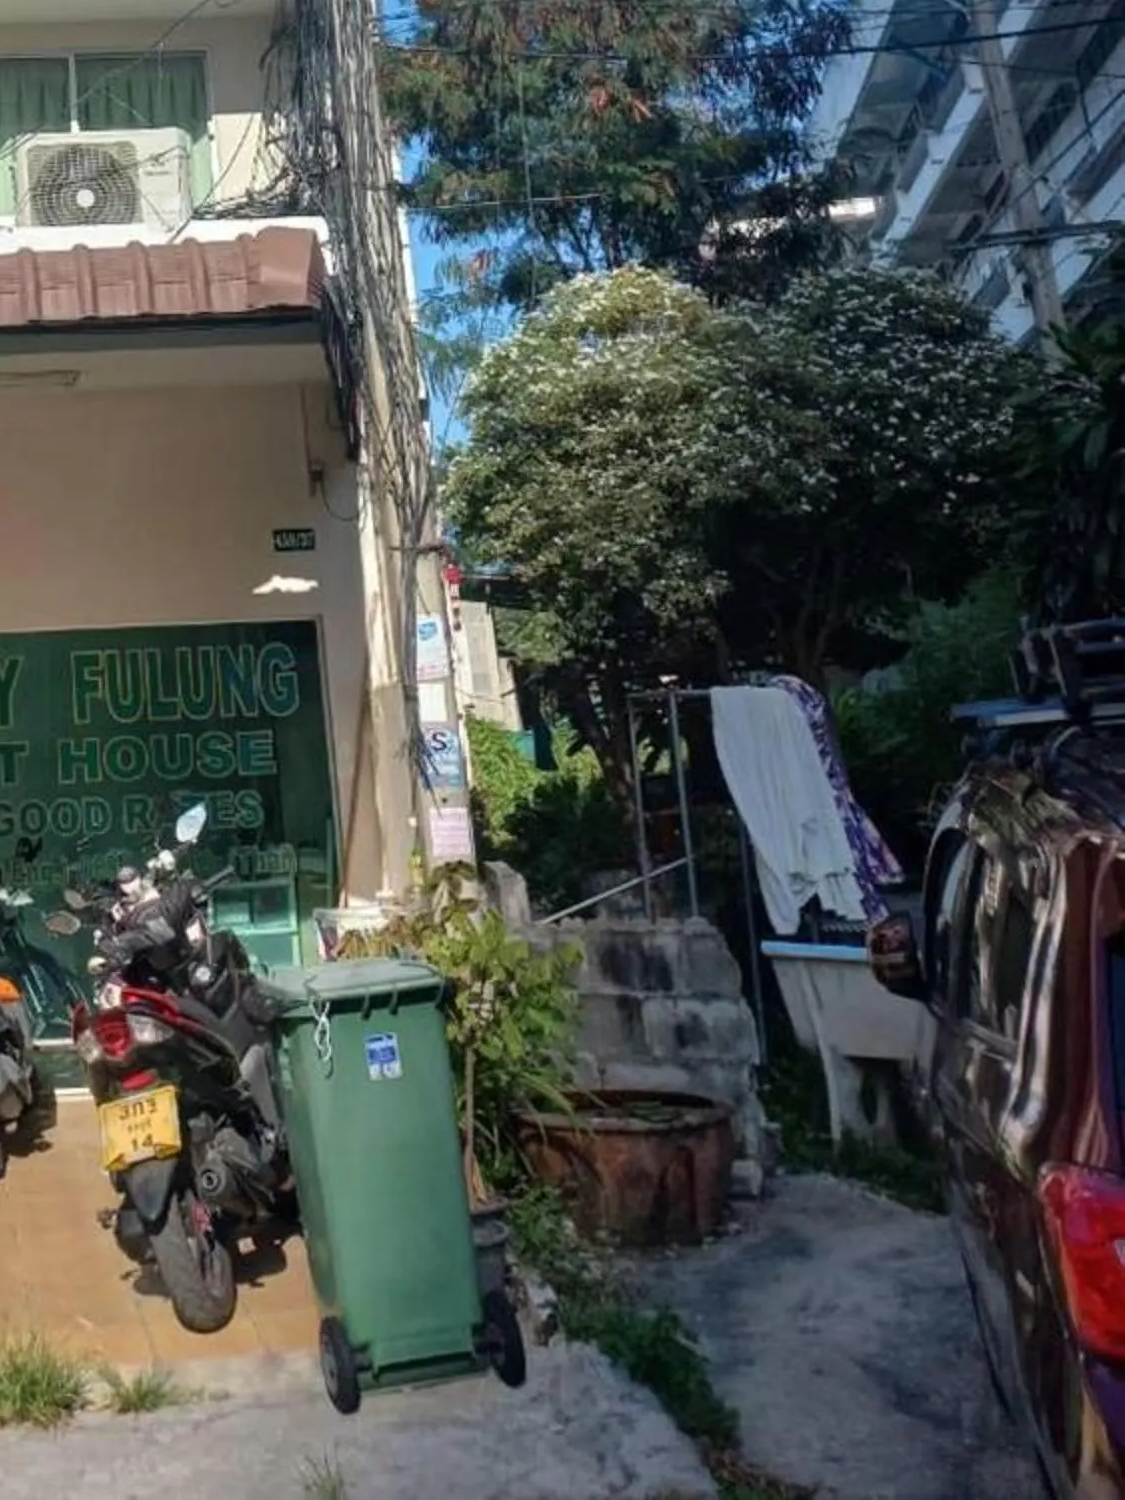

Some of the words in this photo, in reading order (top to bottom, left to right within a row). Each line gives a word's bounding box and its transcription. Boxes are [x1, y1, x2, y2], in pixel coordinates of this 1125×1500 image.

[70, 642, 300, 725] FULUNG
[57, 730, 278, 785] HOUSE
[123, 789, 266, 834] RES
